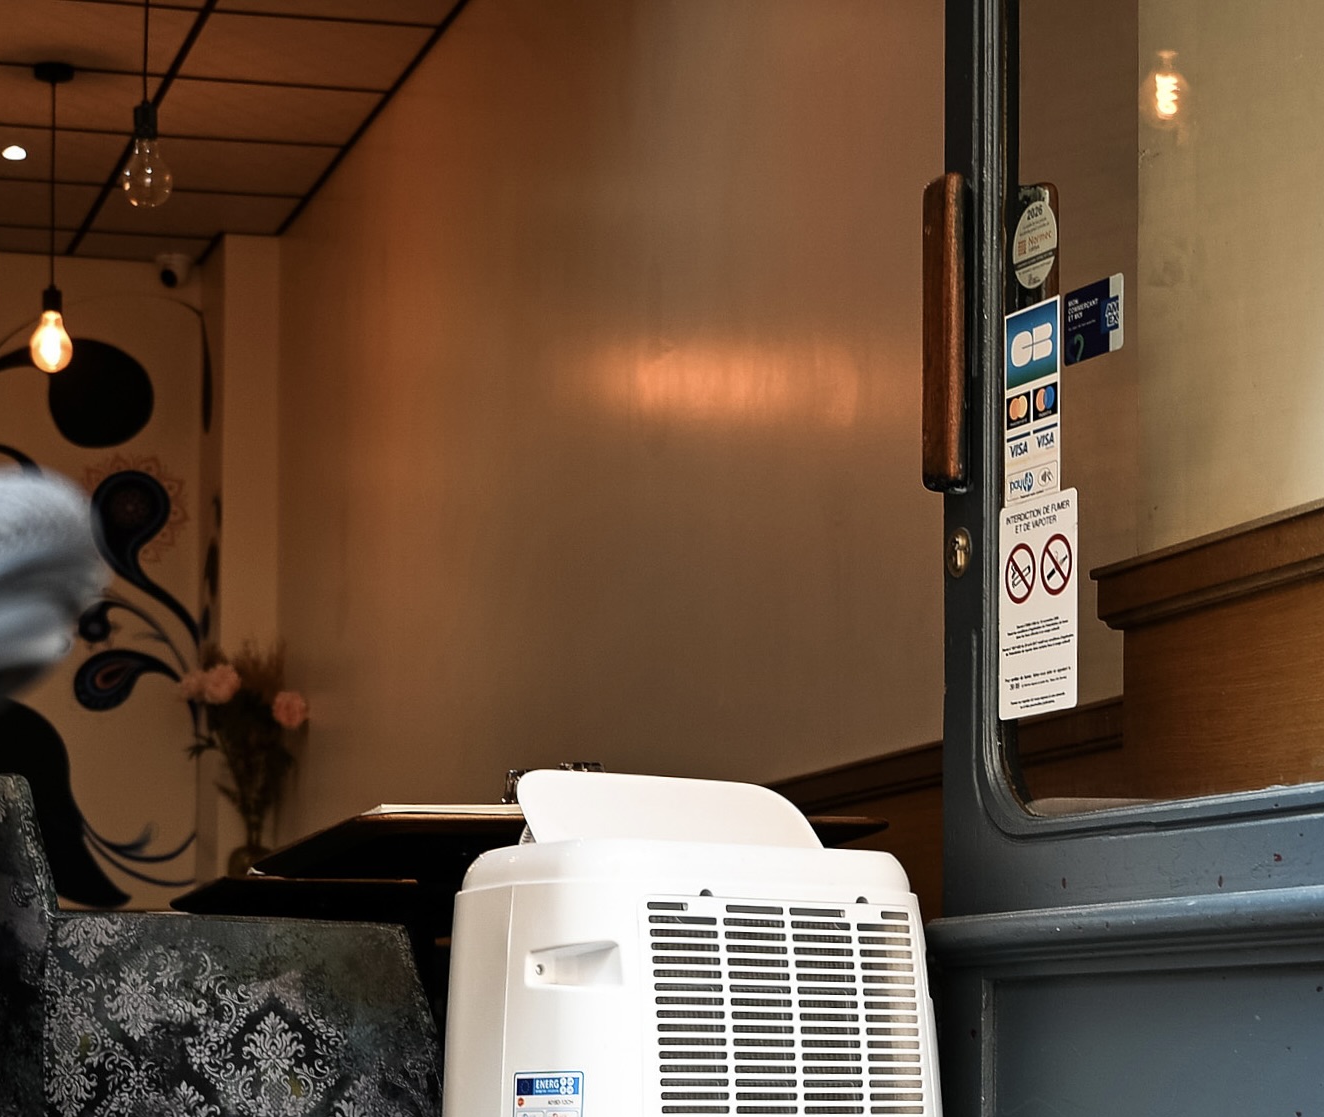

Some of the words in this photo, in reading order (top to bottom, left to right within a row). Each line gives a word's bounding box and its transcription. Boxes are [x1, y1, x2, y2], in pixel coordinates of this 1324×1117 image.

[1011, 322, 1053, 368] CB
[1036, 431, 1055, 448] VISA
[1010, 441, 1028, 458] VISA
[1005, 508, 1042, 526] INTERDICTION
[1042, 504, 1050, 515] DE
[1051, 499, 1071, 512] FUMER
[1014, 524, 1022, 534] ET
[1023, 521, 1031, 532] DE
[1031, 514, 1057, 528] VAPOTER
[535, 1079, 560, 1090] ENERG
